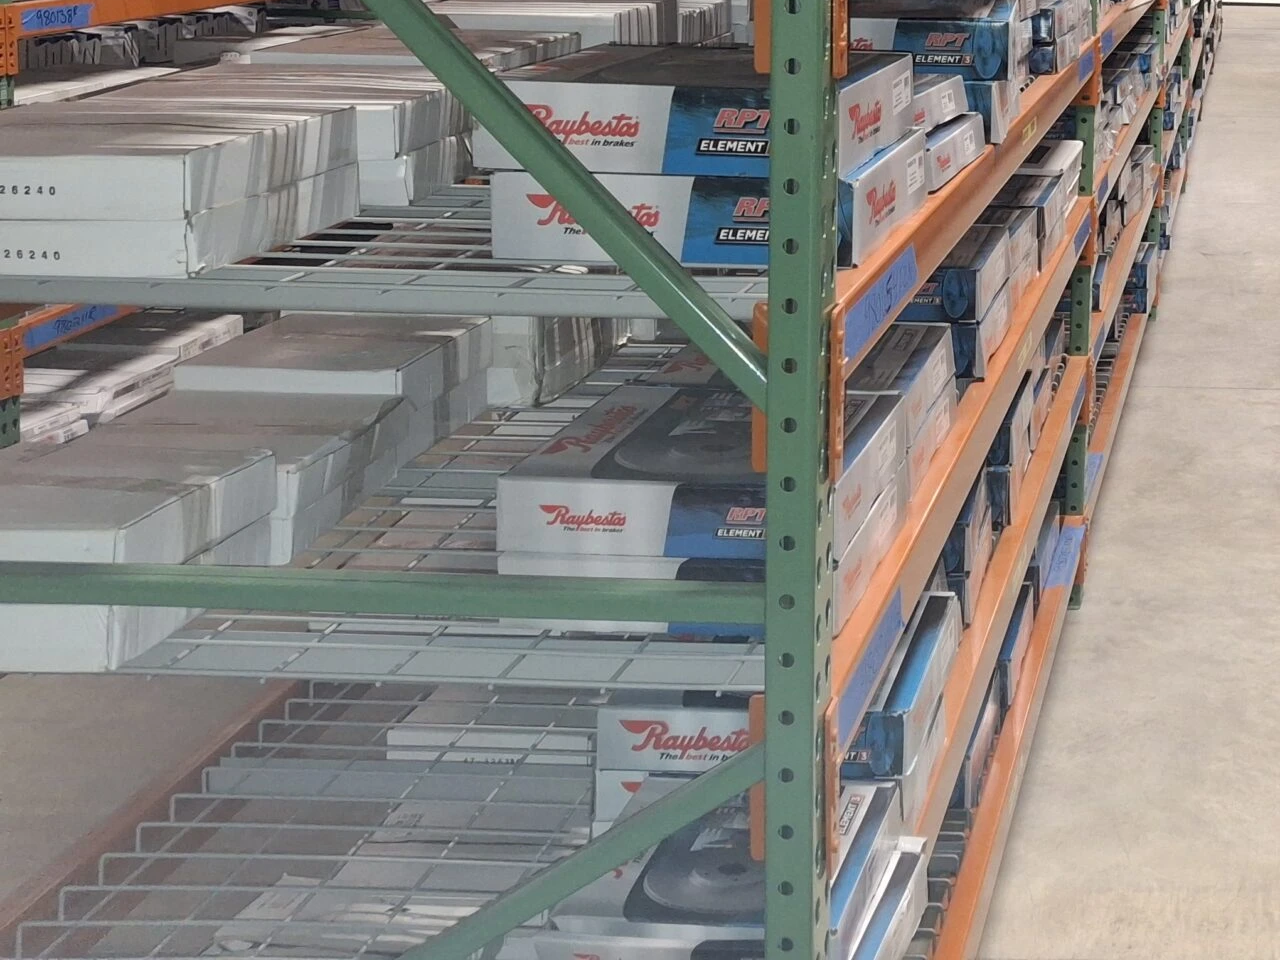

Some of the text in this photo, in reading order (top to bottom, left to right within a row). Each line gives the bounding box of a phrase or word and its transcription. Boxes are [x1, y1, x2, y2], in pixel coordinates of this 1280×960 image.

[925, 33, 969, 48] RPT
[915, 54, 972, 65] ELEMENT 3
[591, 138, 601, 147] in
[602, 139, 635, 148] brakes
[700, 140, 766, 153] ELEMENT
[539, 504, 627, 531] Raybestos
[717, 528, 762, 538] ELEMENT
[618, 719, 752, 758] Raybesto
[660, 752, 678, 761] The
